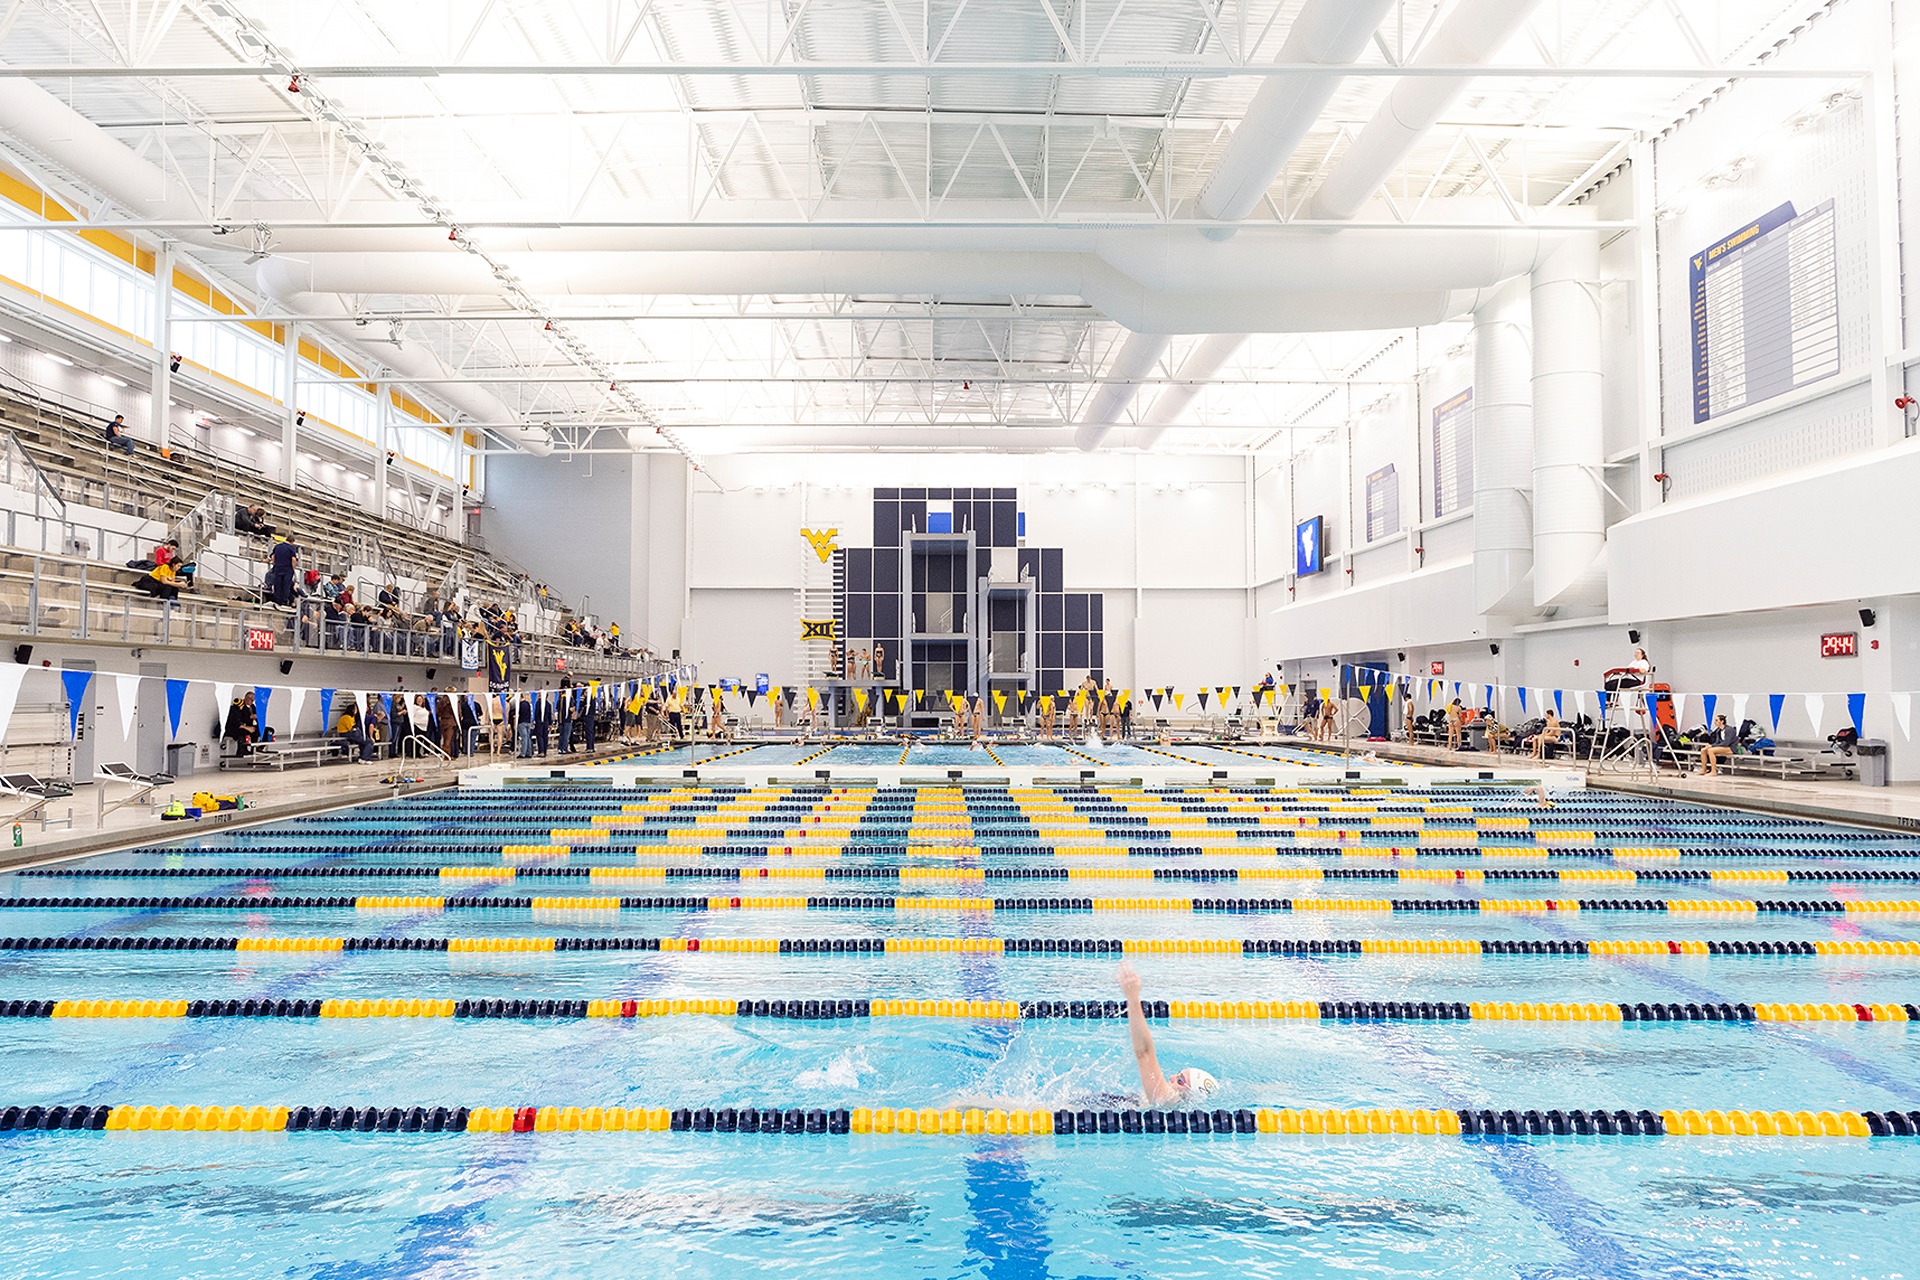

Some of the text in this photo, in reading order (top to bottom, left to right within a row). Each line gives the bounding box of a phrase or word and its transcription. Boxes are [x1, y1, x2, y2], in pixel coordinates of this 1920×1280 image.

[1708, 241, 1727, 260] MEN'S
[1727, 224, 1760, 249] SWIMMING
[802, 621, 834, 638] XII
[249, 630, 273, 650] 29:44
[1823, 636, 1853, 656] 29:44
